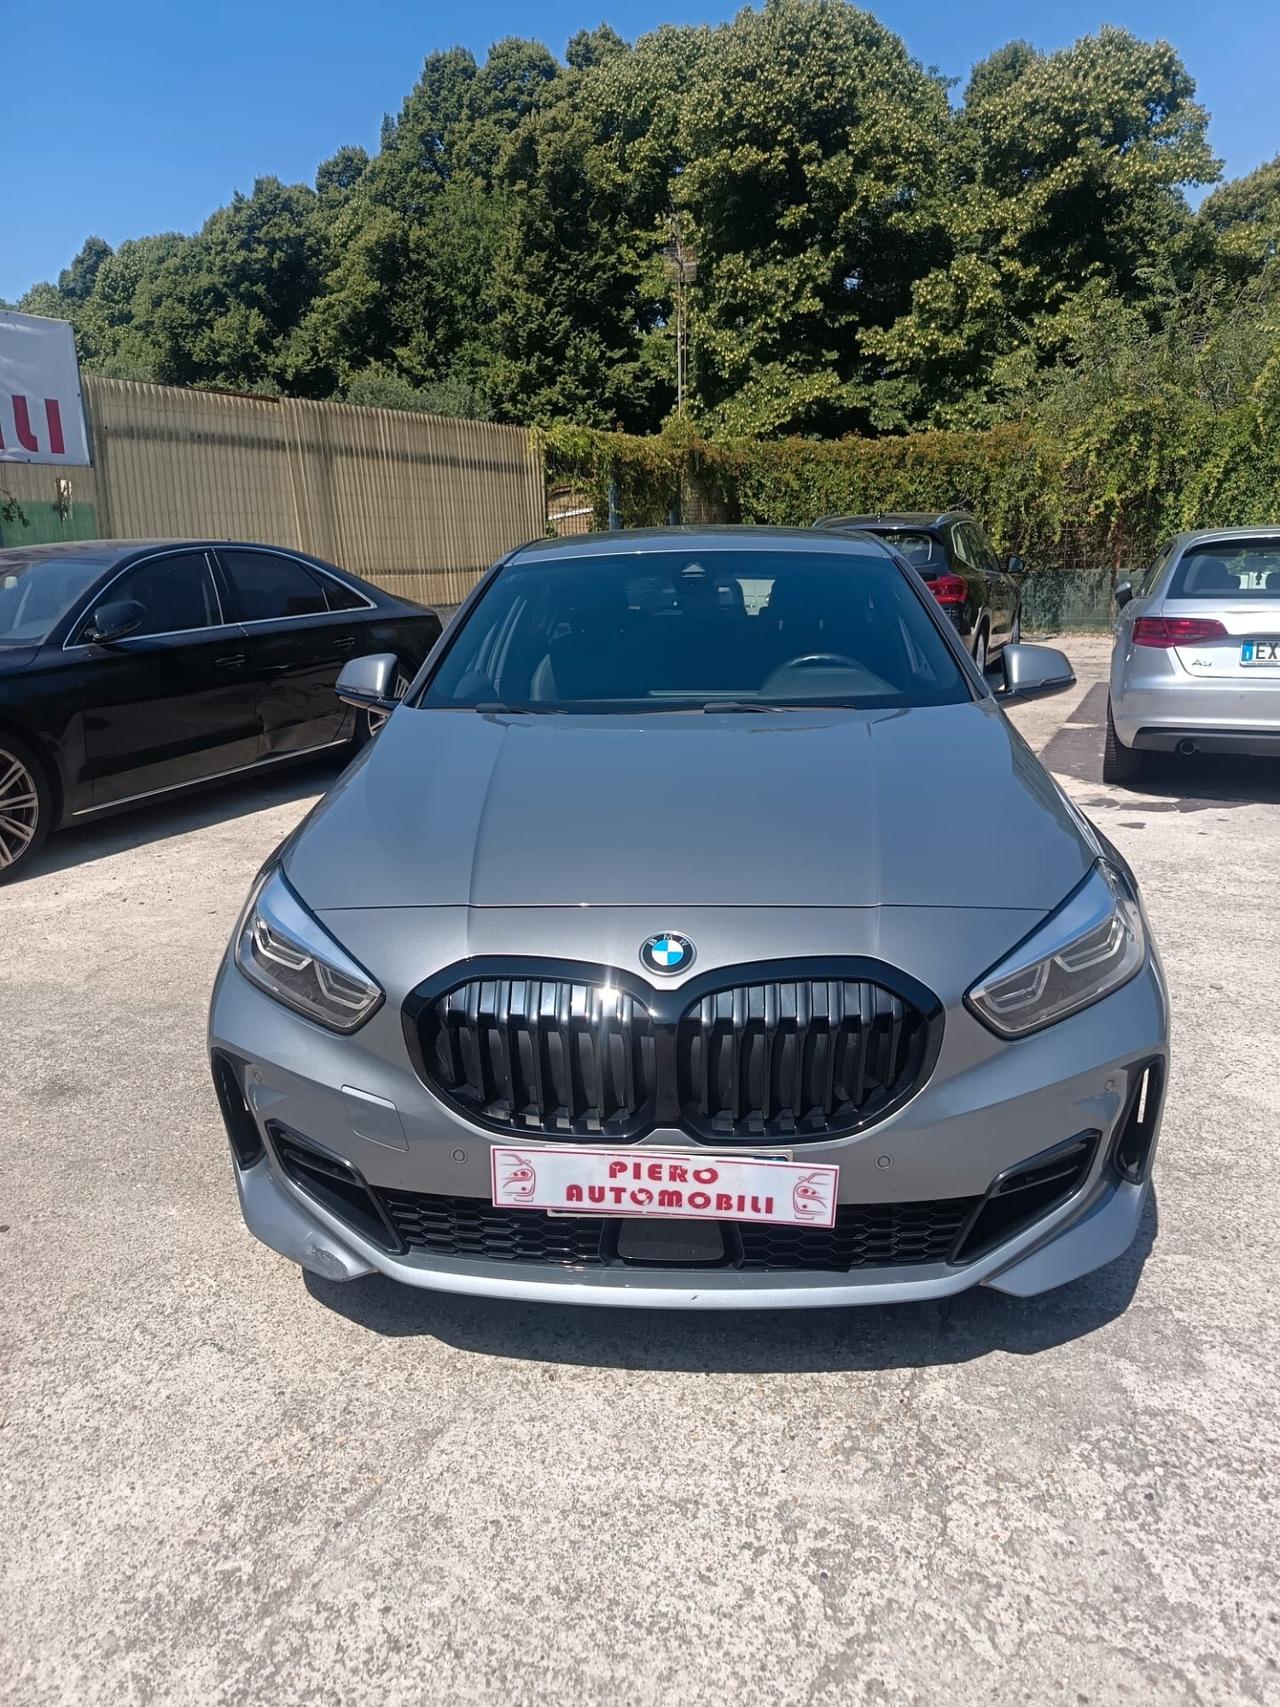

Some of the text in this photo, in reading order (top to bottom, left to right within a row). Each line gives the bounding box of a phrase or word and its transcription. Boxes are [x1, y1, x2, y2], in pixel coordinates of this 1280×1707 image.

[648, 933, 689, 947] BMW
[609, 1161, 719, 1185] PIERO
[566, 1184, 774, 1214] AUTOMOBILI
